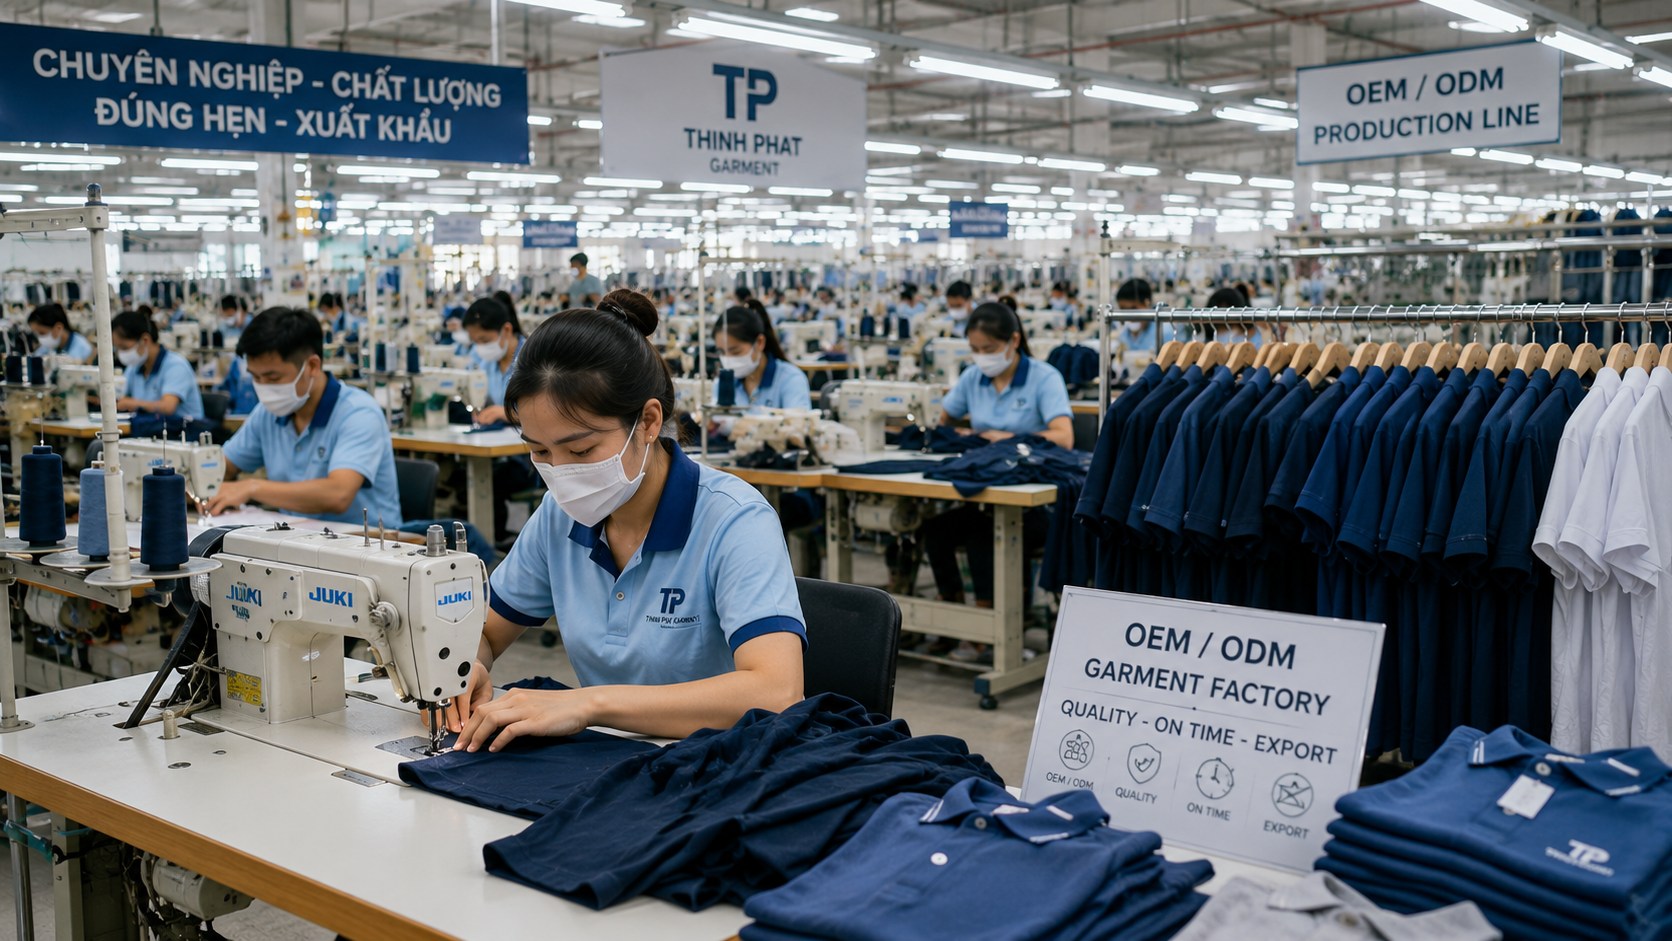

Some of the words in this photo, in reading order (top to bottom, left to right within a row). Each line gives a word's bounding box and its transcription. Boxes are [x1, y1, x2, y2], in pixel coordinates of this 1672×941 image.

[33, 48, 178, 87] CHUYÊN
[188, 59, 304, 99] NGHIỆP
[332, 65, 406, 101] CHẤT
[414, 76, 502, 110] LƯỢNG
[712, 63, 778, 121] TP
[1346, 78, 1407, 106] OEM
[1415, 74, 1427, 102] /
[1435, 67, 1504, 96] ODM
[95, 92, 193, 131] ĐÚNG
[203, 104, 267, 138] HẸN
[296, 104, 370, 139] XUẤT
[377, 109, 452, 144] KHẨU
[1313, 109, 1473, 146] PRODUCTION
[1482, 103, 1541, 129] LINE
[684, 128, 747, 155] THINH
[753, 133, 803, 157] PHAT
[709, 157, 780, 178] GARMENT
[309, 586, 353, 608] JUKI
[437, 590, 472, 606] JUKI
[660, 588, 686, 614] TP
[1125, 622, 1191, 654] OEM
[1197, 632, 1213, 658] /
[1220, 635, 1296, 670] ODM
[1084, 658, 1204, 695] GARMENT
[1210, 677, 1330, 716] FACTORY
[1061, 699, 1138, 727] QUALITY
[1154, 716, 1183, 736] ON
[1189, 722, 1235, 746] TIME
[1254, 734, 1338, 765] EXPORT
[1046, 772, 1066, 785] OEM
[1073, 778, 1094, 790] ODM
[1115, 787, 1158, 805] QUALITY
[1187, 802, 1203, 815] ON
[1206, 806, 1231, 821] TIME
[1263, 820, 1310, 840] EXPORT
